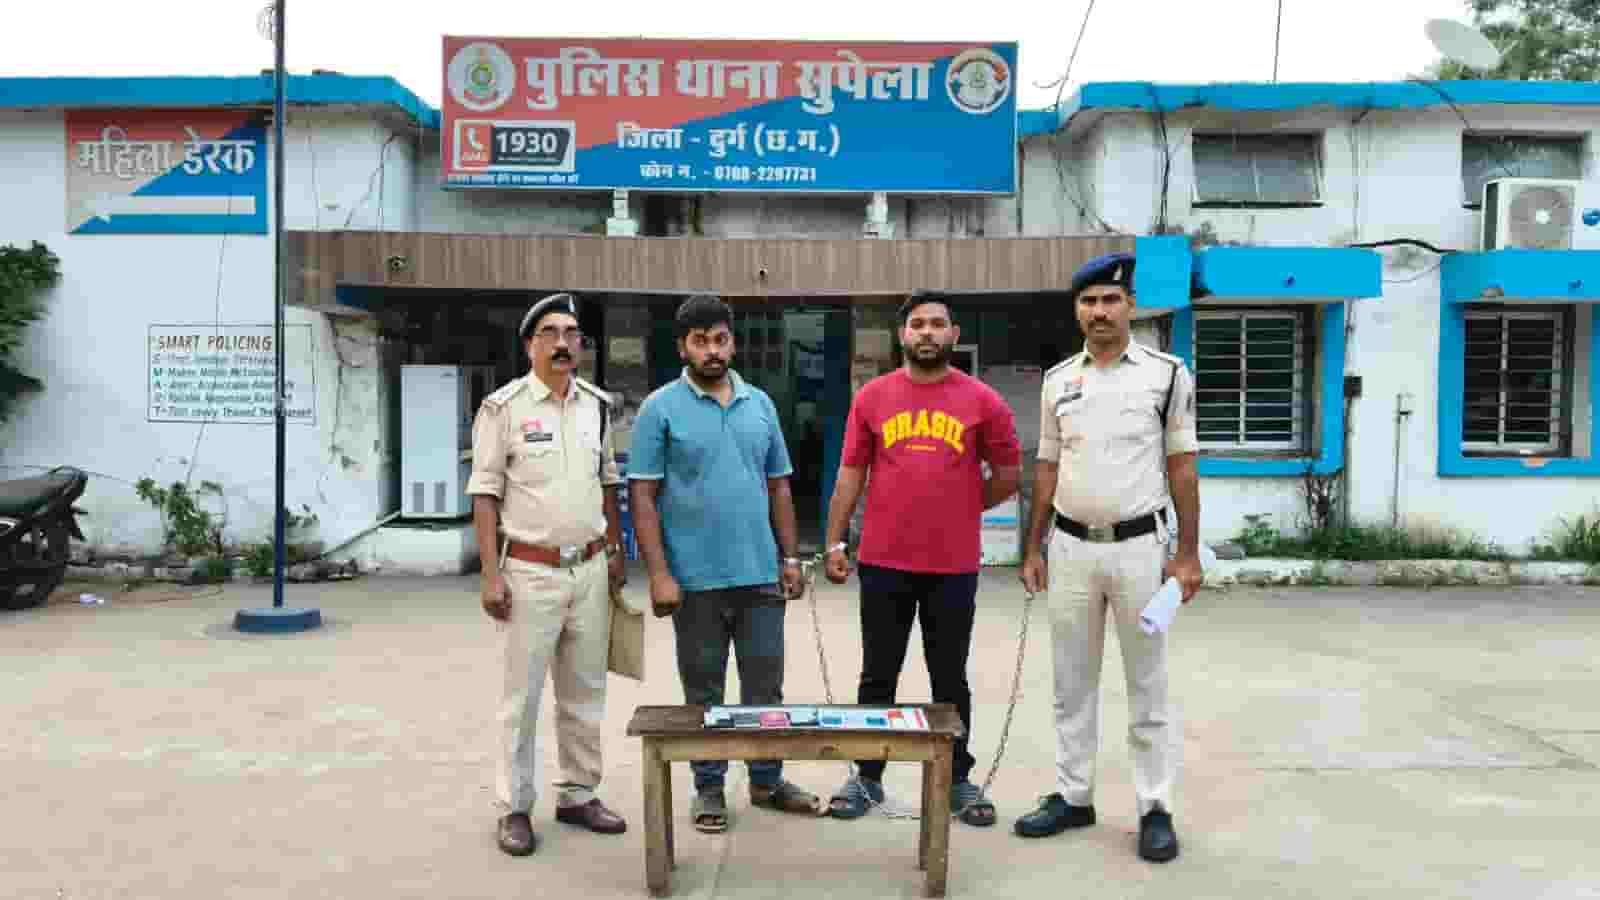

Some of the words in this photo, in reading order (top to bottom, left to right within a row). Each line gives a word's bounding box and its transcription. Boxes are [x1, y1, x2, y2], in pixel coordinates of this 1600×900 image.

[524, 48, 665, 110] पुलिस
[675, 59, 782, 99] थाना
[796, 50, 934, 114] सुपेला
[76, 125, 178, 181] महिला
[183, 126, 256, 176] डेस्क
[496, 131, 558, 154] 1930
[616, 121, 684, 149] जिला
[708, 122, 748, 158] दुर्ग
[207, 335, 273, 352] POLICING
